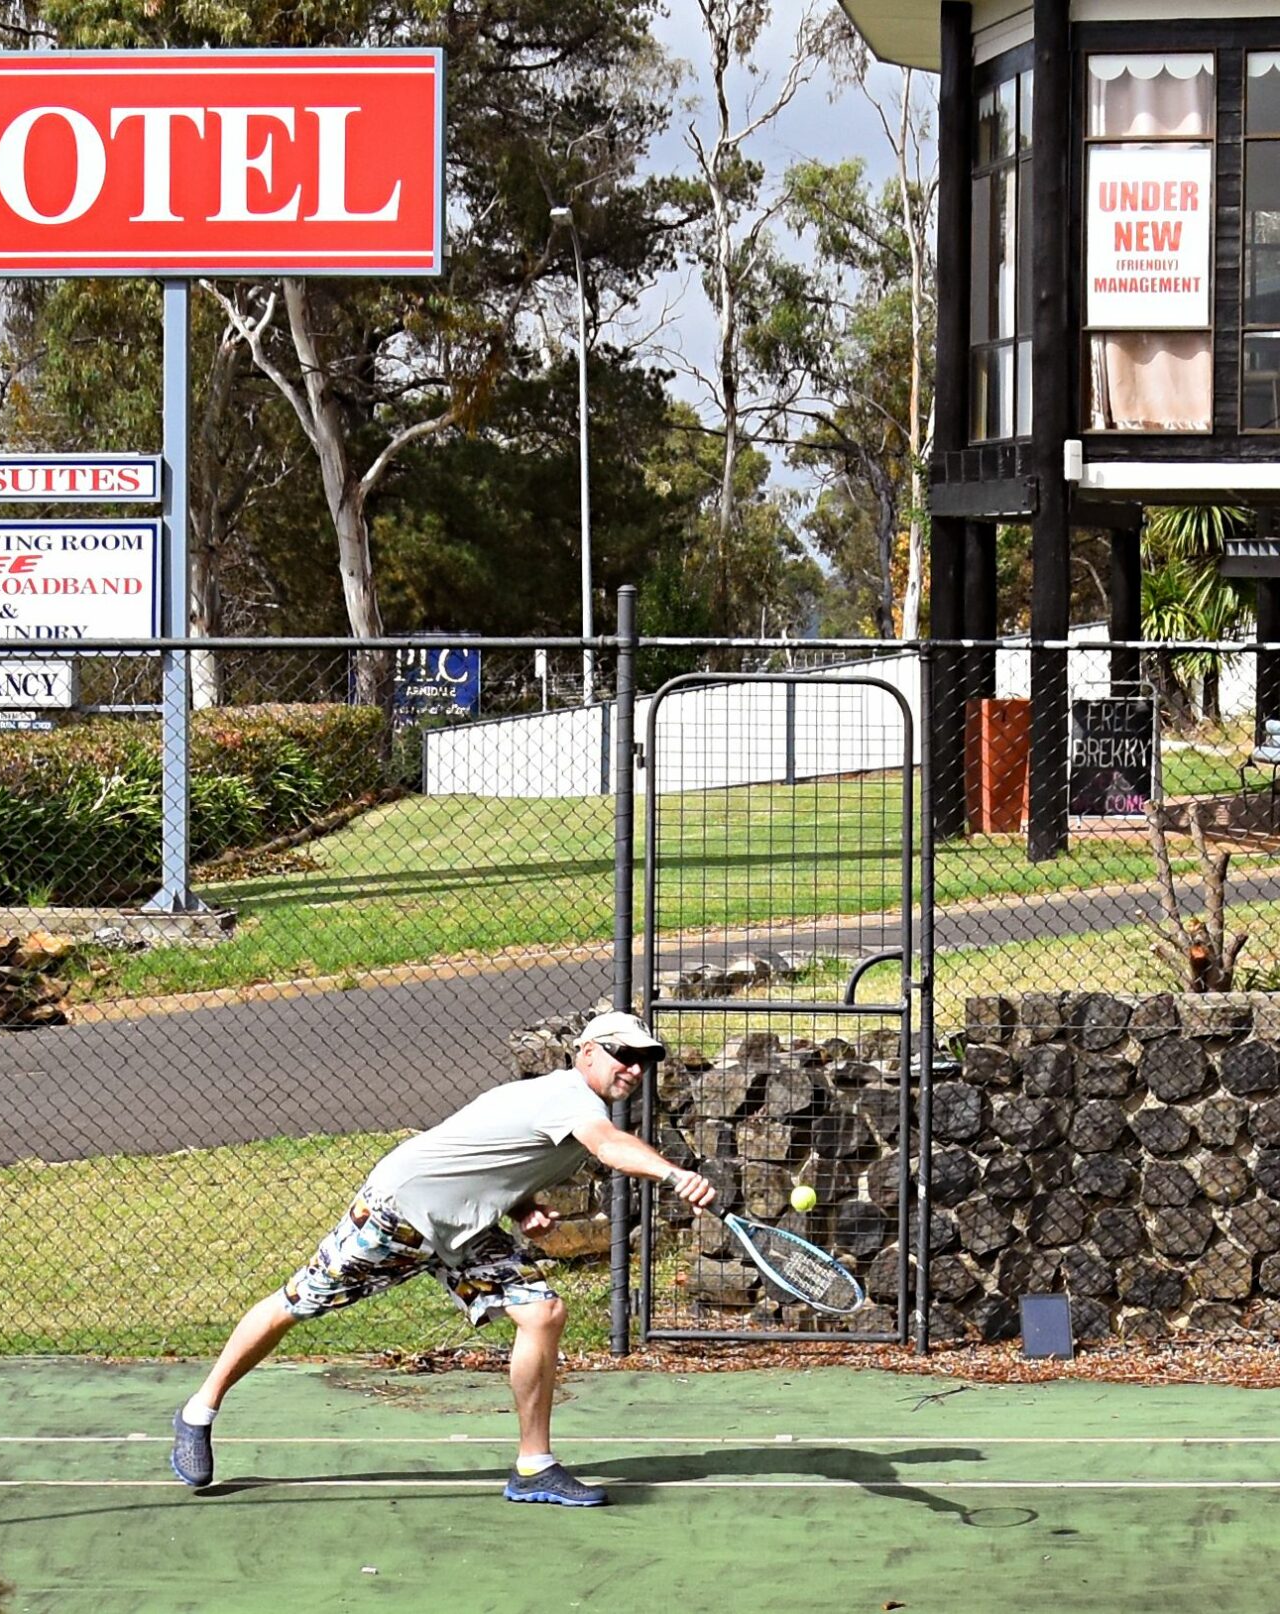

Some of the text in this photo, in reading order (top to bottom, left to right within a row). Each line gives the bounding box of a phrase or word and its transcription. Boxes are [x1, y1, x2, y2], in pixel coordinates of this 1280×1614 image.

[1099, 181, 1199, 212] UNDER
[1114, 221, 1182, 252] NEW
[1116, 259, 1179, 271] (FRIENDLY)
[1094, 277, 1201, 293] MANAGEMENT
[61, 534, 143, 551] ROOM
[1087, 702, 1136, 732] FREE
[1072, 738, 1152, 768] BREKKY
